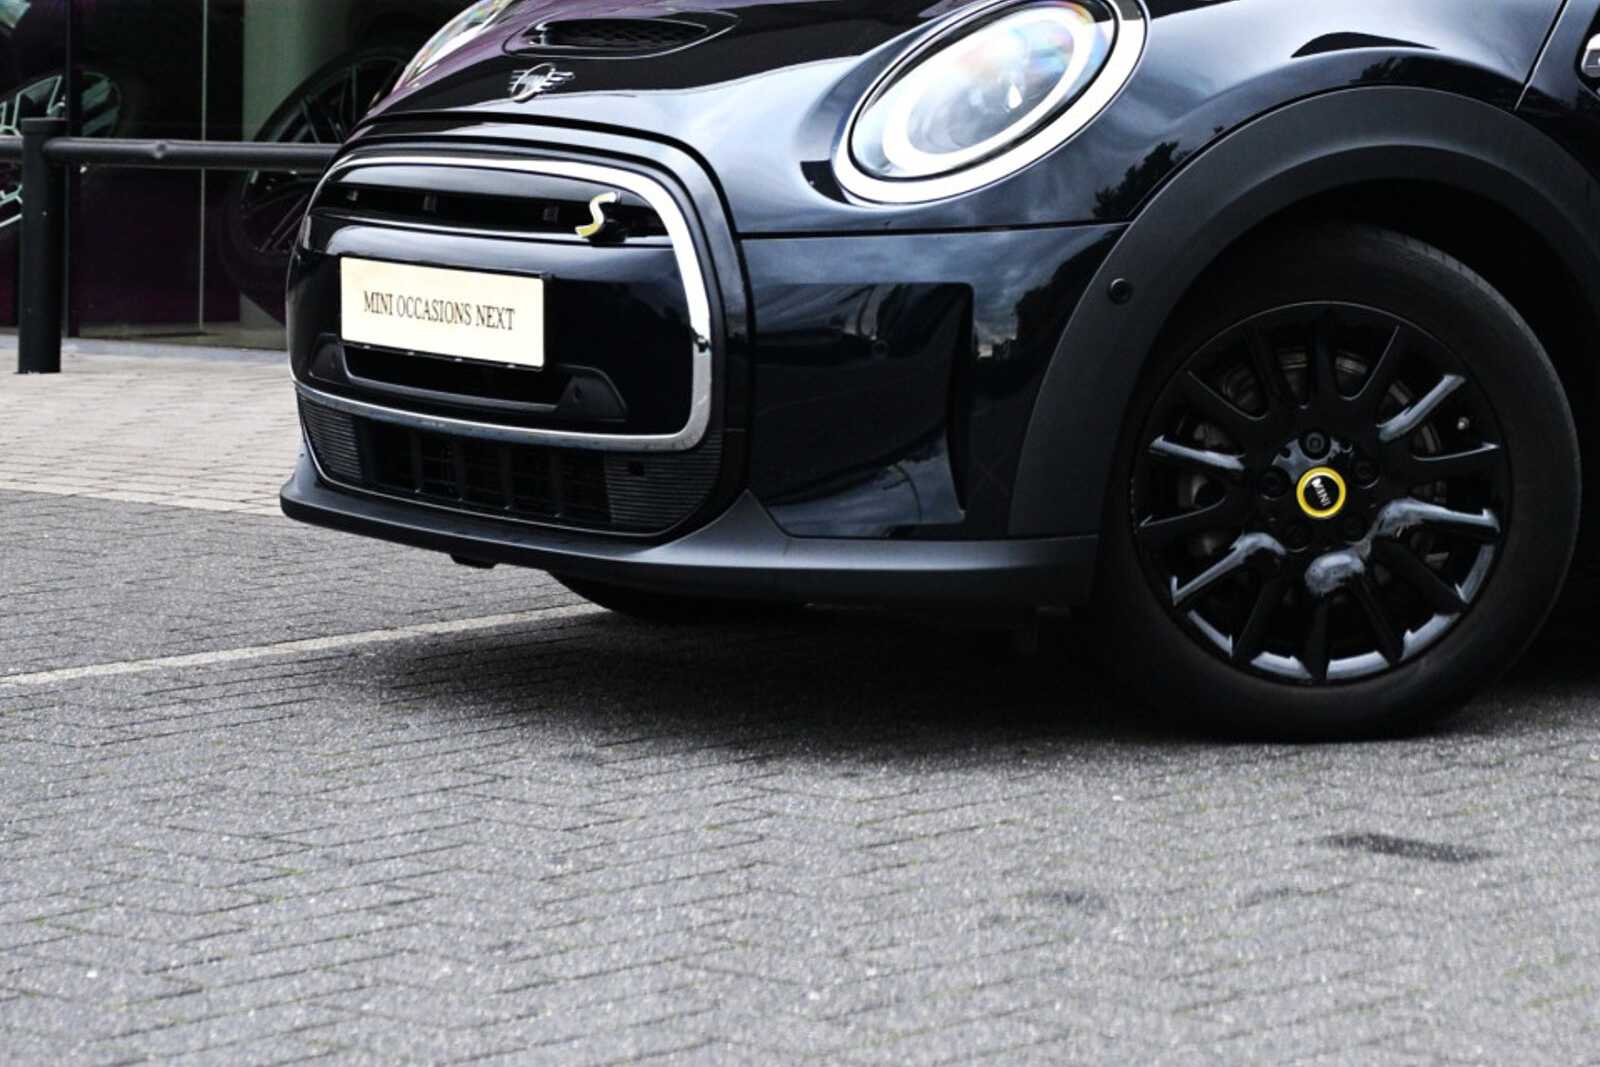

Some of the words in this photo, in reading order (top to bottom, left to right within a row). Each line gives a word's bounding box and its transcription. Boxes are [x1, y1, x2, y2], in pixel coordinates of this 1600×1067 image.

[363, 290, 393, 316] MINI
[396, 295, 472, 326] OCCASIONS
[476, 303, 515, 331] NEXT
